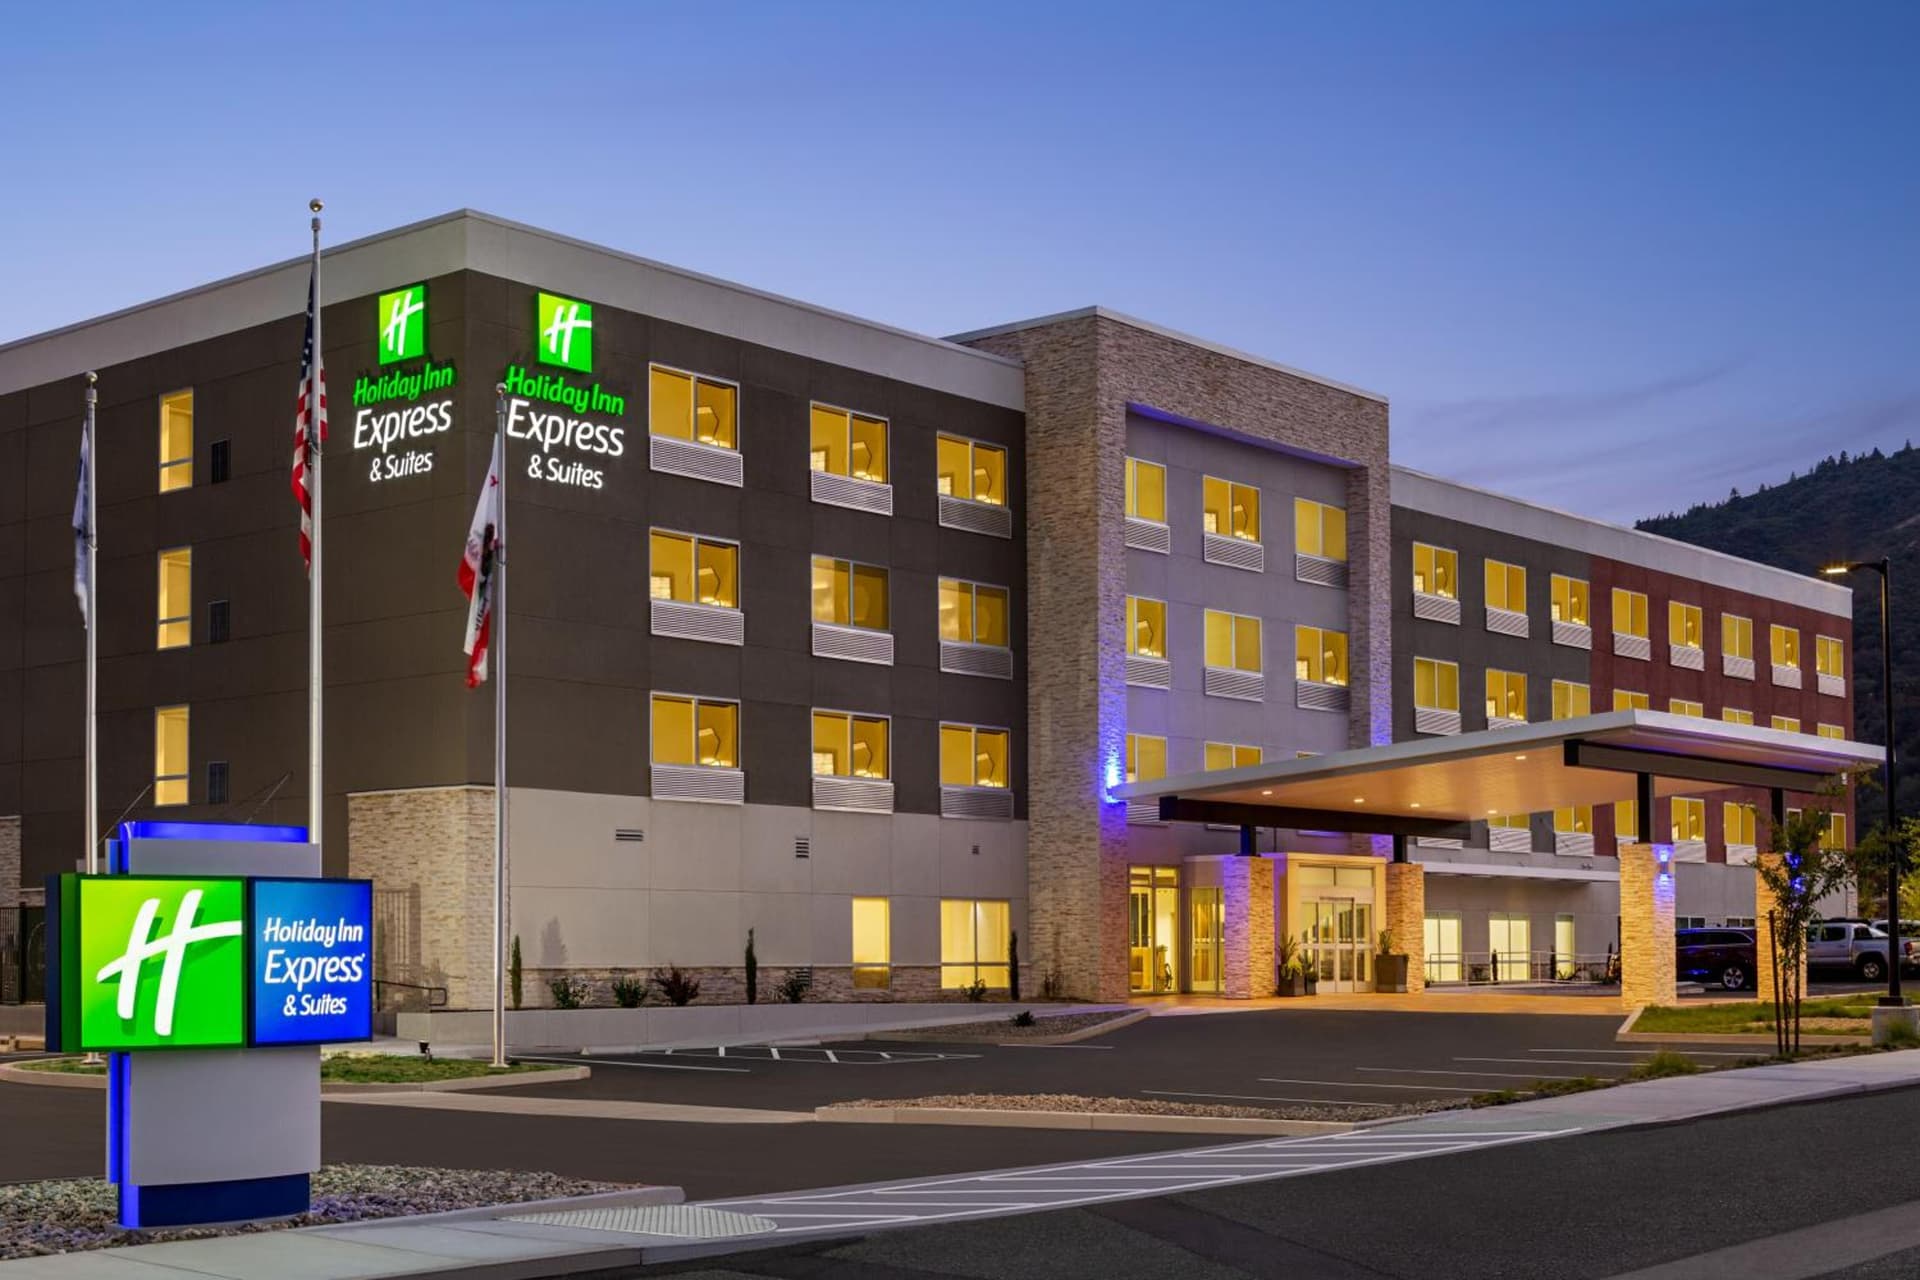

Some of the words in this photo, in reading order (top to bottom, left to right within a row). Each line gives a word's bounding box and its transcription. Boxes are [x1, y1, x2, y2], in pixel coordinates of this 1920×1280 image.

[353, 369, 421, 406] Holiday
[424, 363, 454, 391] Inn
[506, 365, 590, 414] Holiday
[593, 384, 625, 416] Inn
[353, 400, 453, 453] Express
[507, 399, 625, 457] Express
[369, 458, 382, 482] &
[385, 452, 433, 480] Suites
[527, 454, 542, 479] &
[546, 458, 604, 489] Suites
[263, 918, 337, 947] Holiday
[338, 918, 363, 943] Inn
[264, 949, 363, 992] Express
[283, 995, 297, 1017] &
[300, 994, 348, 1016] Suites
